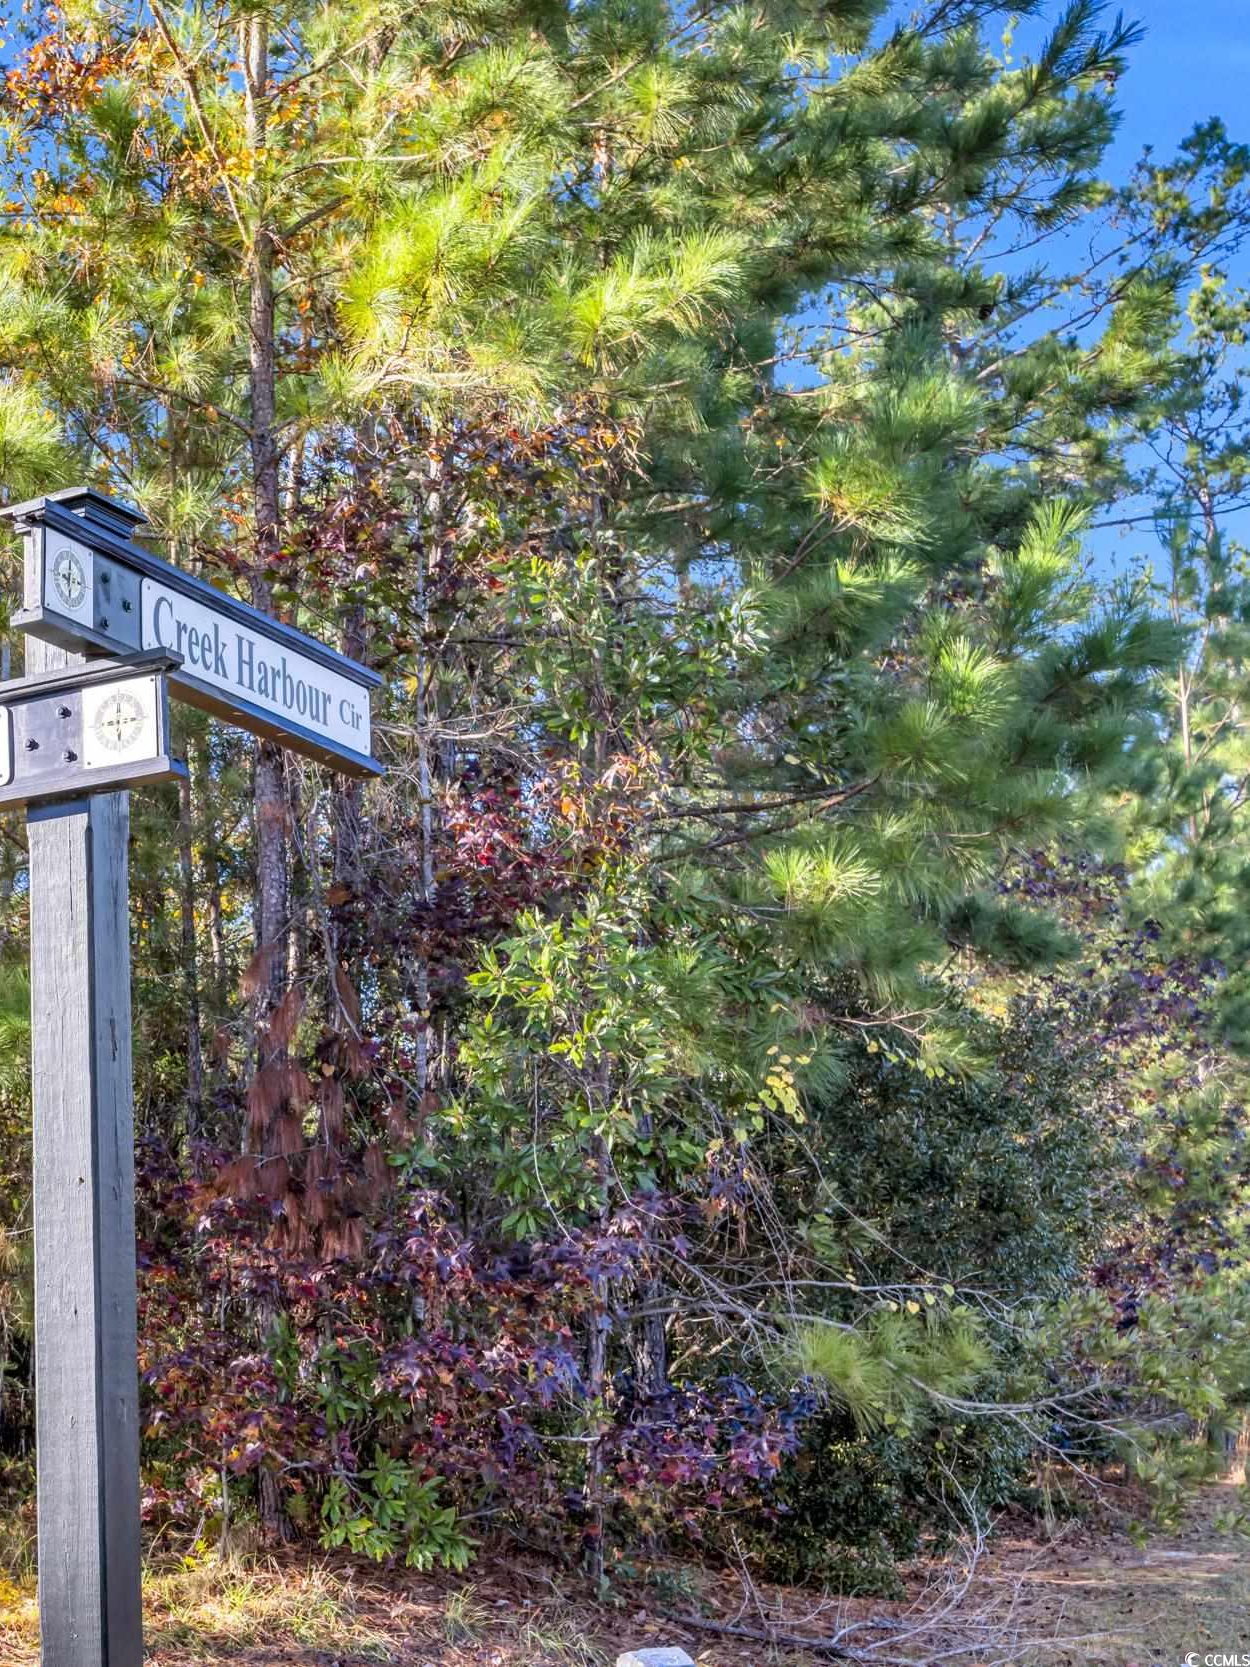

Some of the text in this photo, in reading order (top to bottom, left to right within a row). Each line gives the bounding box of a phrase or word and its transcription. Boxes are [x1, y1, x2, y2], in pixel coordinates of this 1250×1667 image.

[153, 596, 230, 679] Creek
[236, 634, 332, 727] Harbour
[339, 699, 362, 731] Cir
